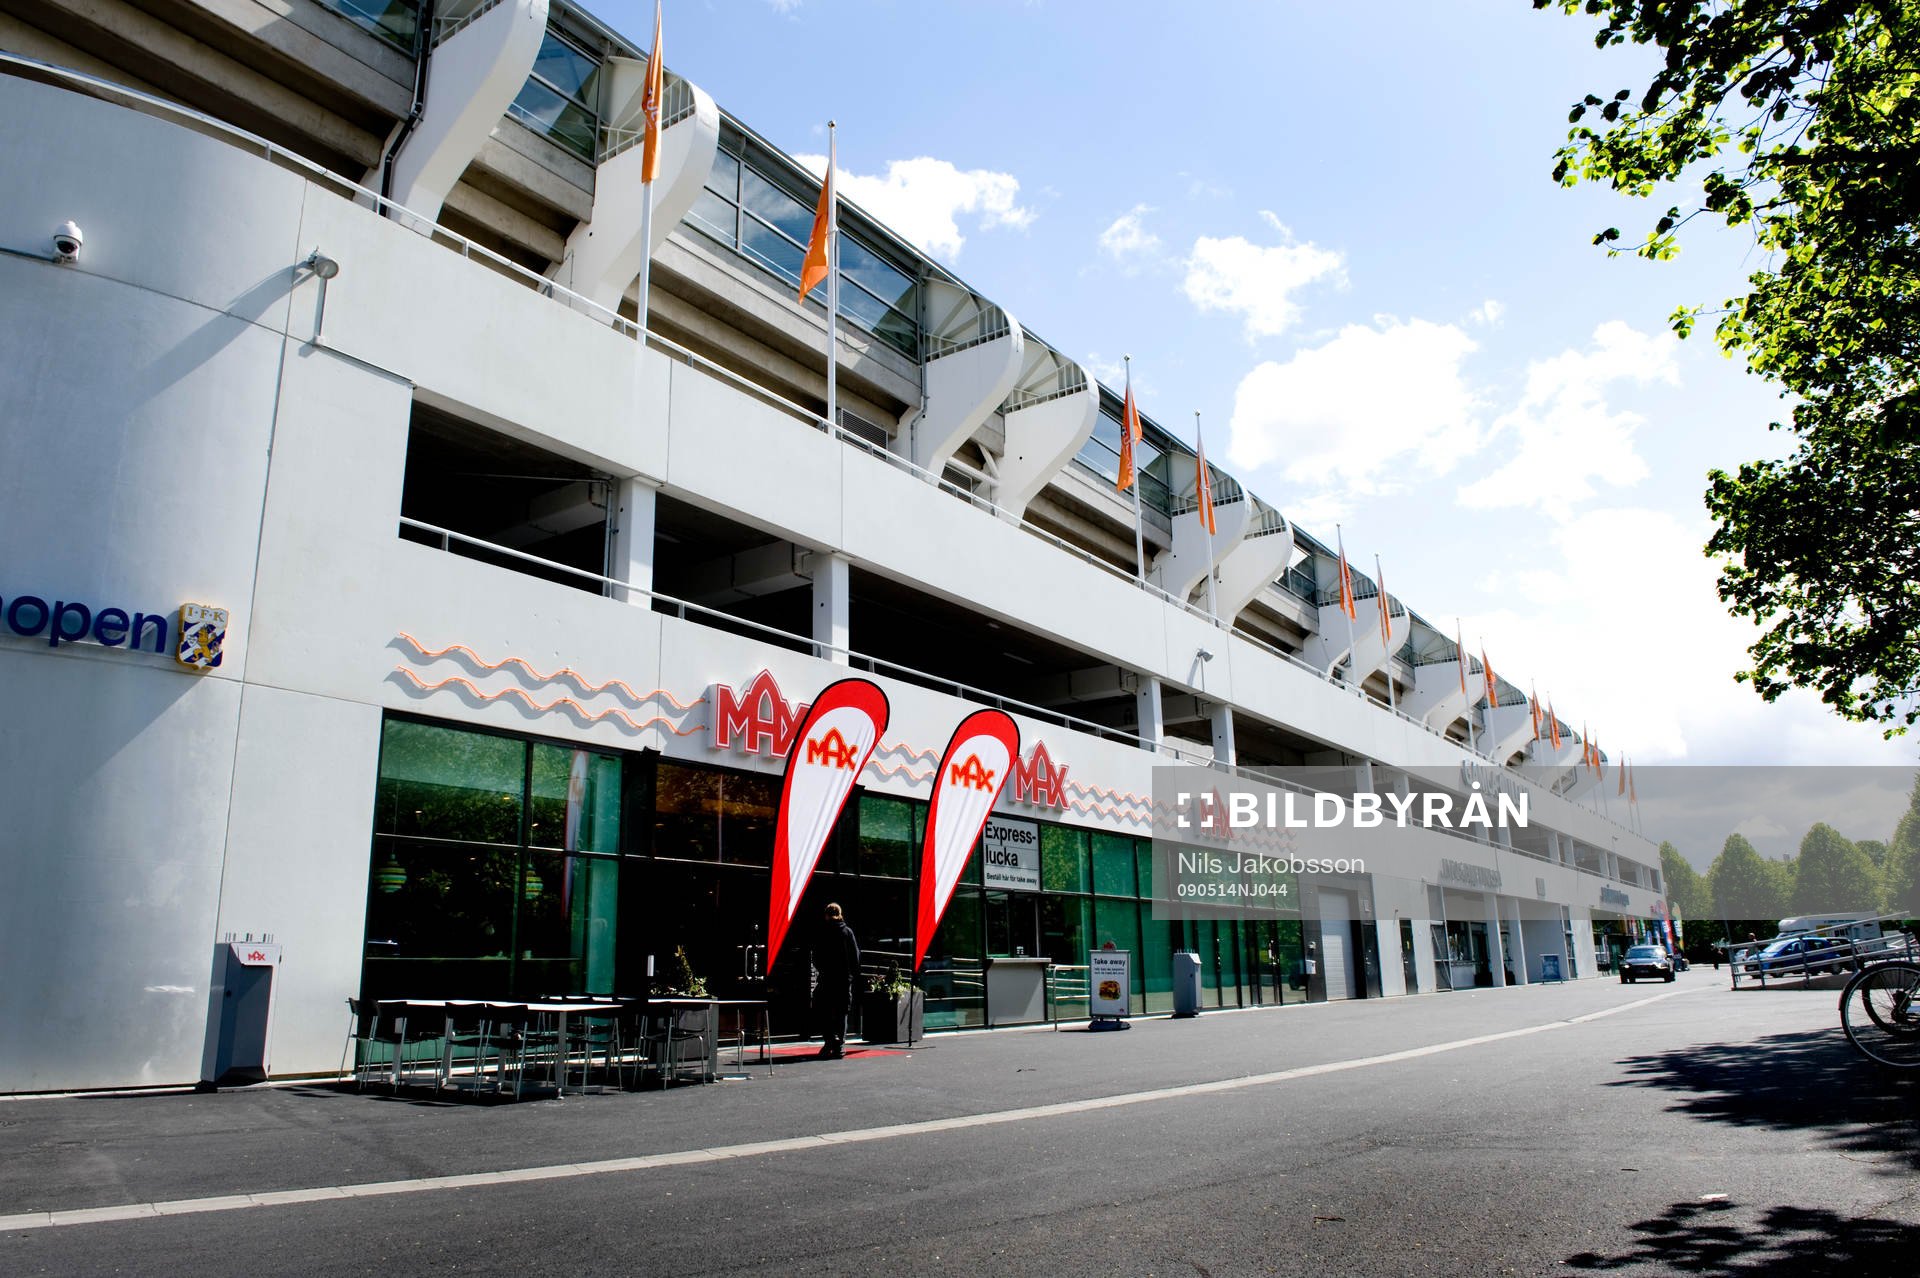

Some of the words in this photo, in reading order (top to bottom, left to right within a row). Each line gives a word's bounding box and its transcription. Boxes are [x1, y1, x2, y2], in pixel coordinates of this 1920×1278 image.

[0, 595, 168, 653] open
[716, 668, 814, 759] MAX
[807, 726, 859, 772] MAX
[950, 752, 996, 794] MAX
[1014, 739, 1071, 810] MAX
[985, 821, 1037, 846] Express-
[985, 844, 1018, 866] lucka
[247, 950, 266, 961] MAX
